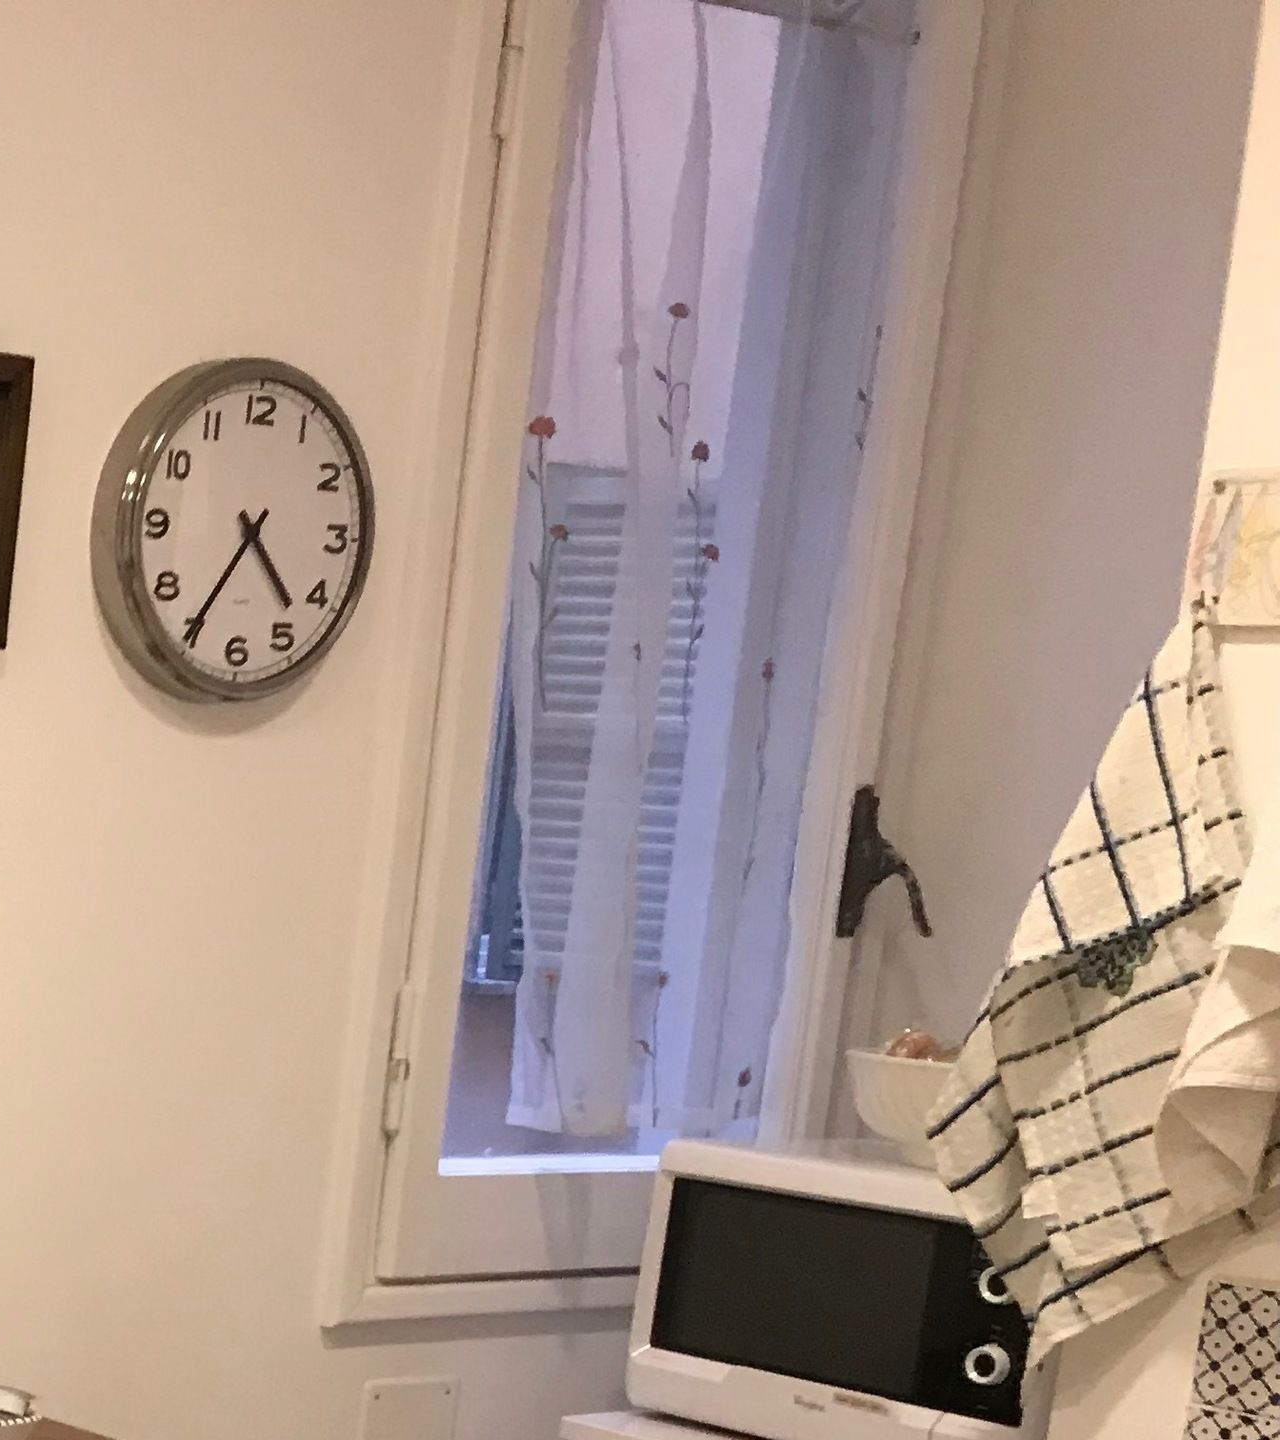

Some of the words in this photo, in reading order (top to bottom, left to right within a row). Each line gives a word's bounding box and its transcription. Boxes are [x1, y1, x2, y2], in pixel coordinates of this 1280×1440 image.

[203, 410, 221, 441] 11
[245, 394, 277, 426] 12
[298, 414, 307, 444] 1
[166, 449, 191, 480] 10
[317, 462, 341, 492] 2
[144, 508, 170, 539] 9
[323, 523, 348, 554] 3
[153, 571, 180, 601] 8
[305, 578, 328, 608] 4
[185, 616, 205, 649] 7
[269, 622, 294, 651] 5
[225, 635, 249, 667] 6
